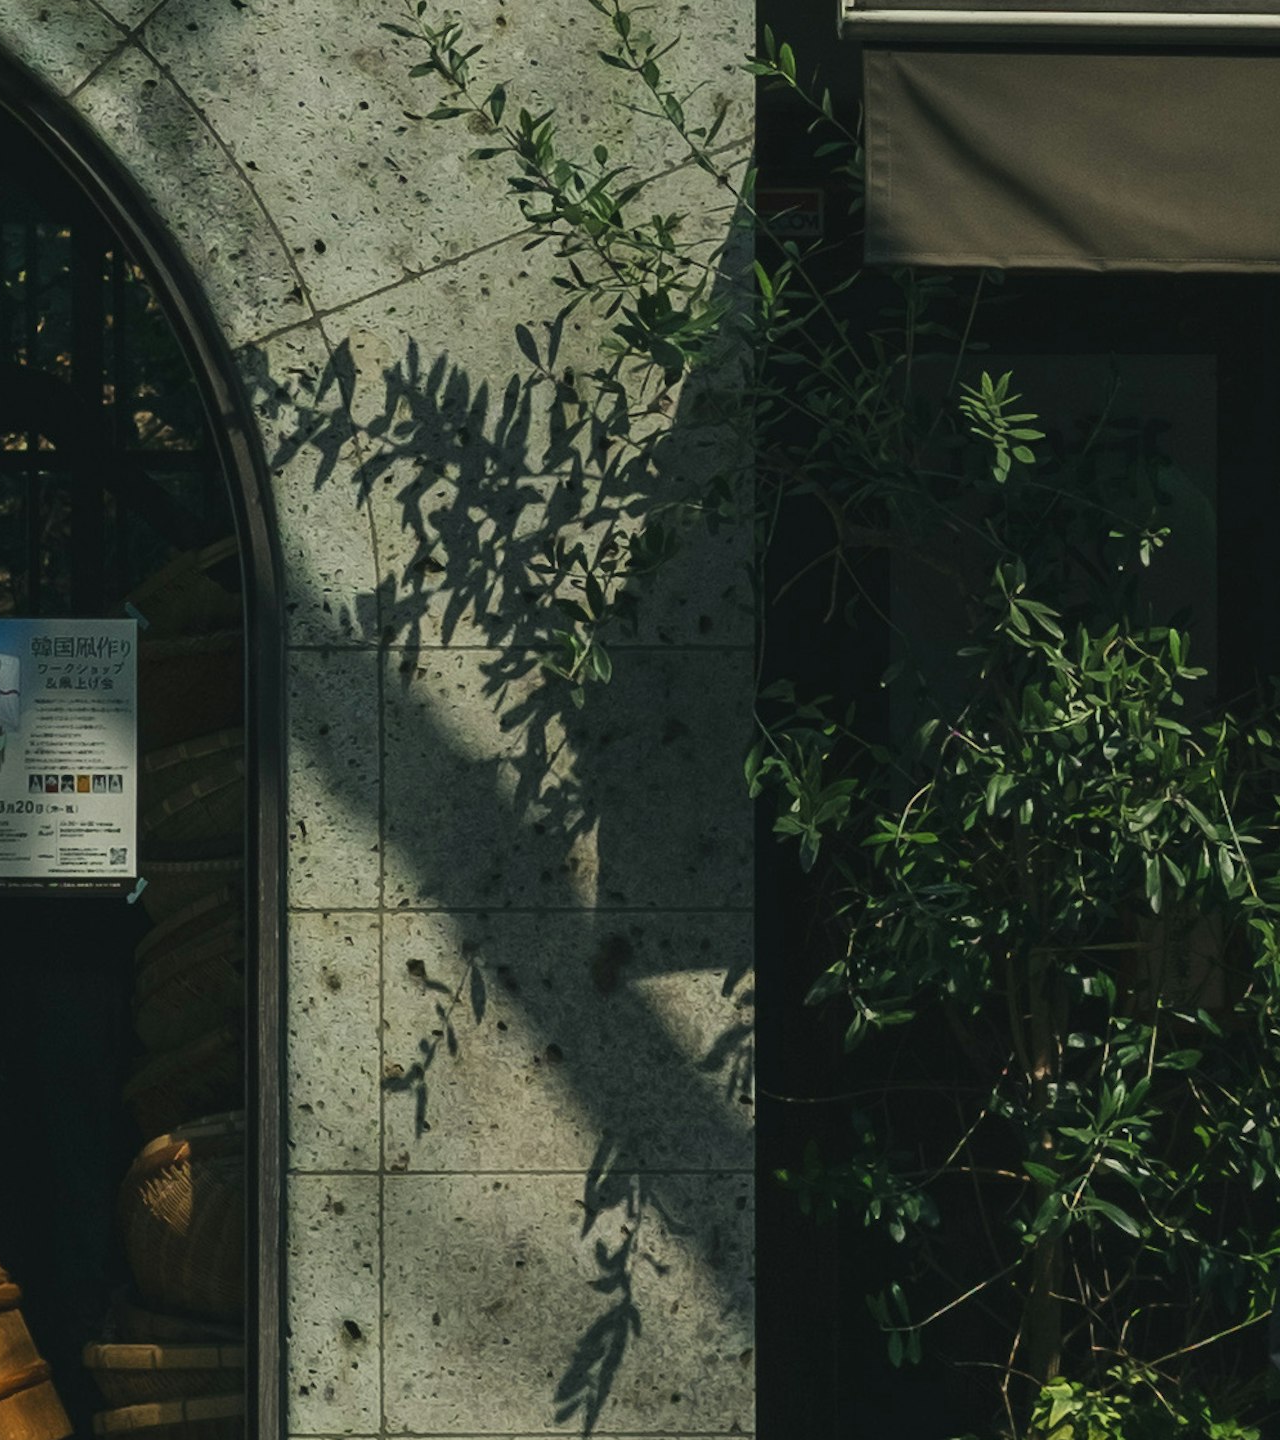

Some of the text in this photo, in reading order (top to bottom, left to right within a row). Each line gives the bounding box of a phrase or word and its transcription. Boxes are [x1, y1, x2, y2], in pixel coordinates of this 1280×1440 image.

[38, 662, 124, 675] ワークショップ
